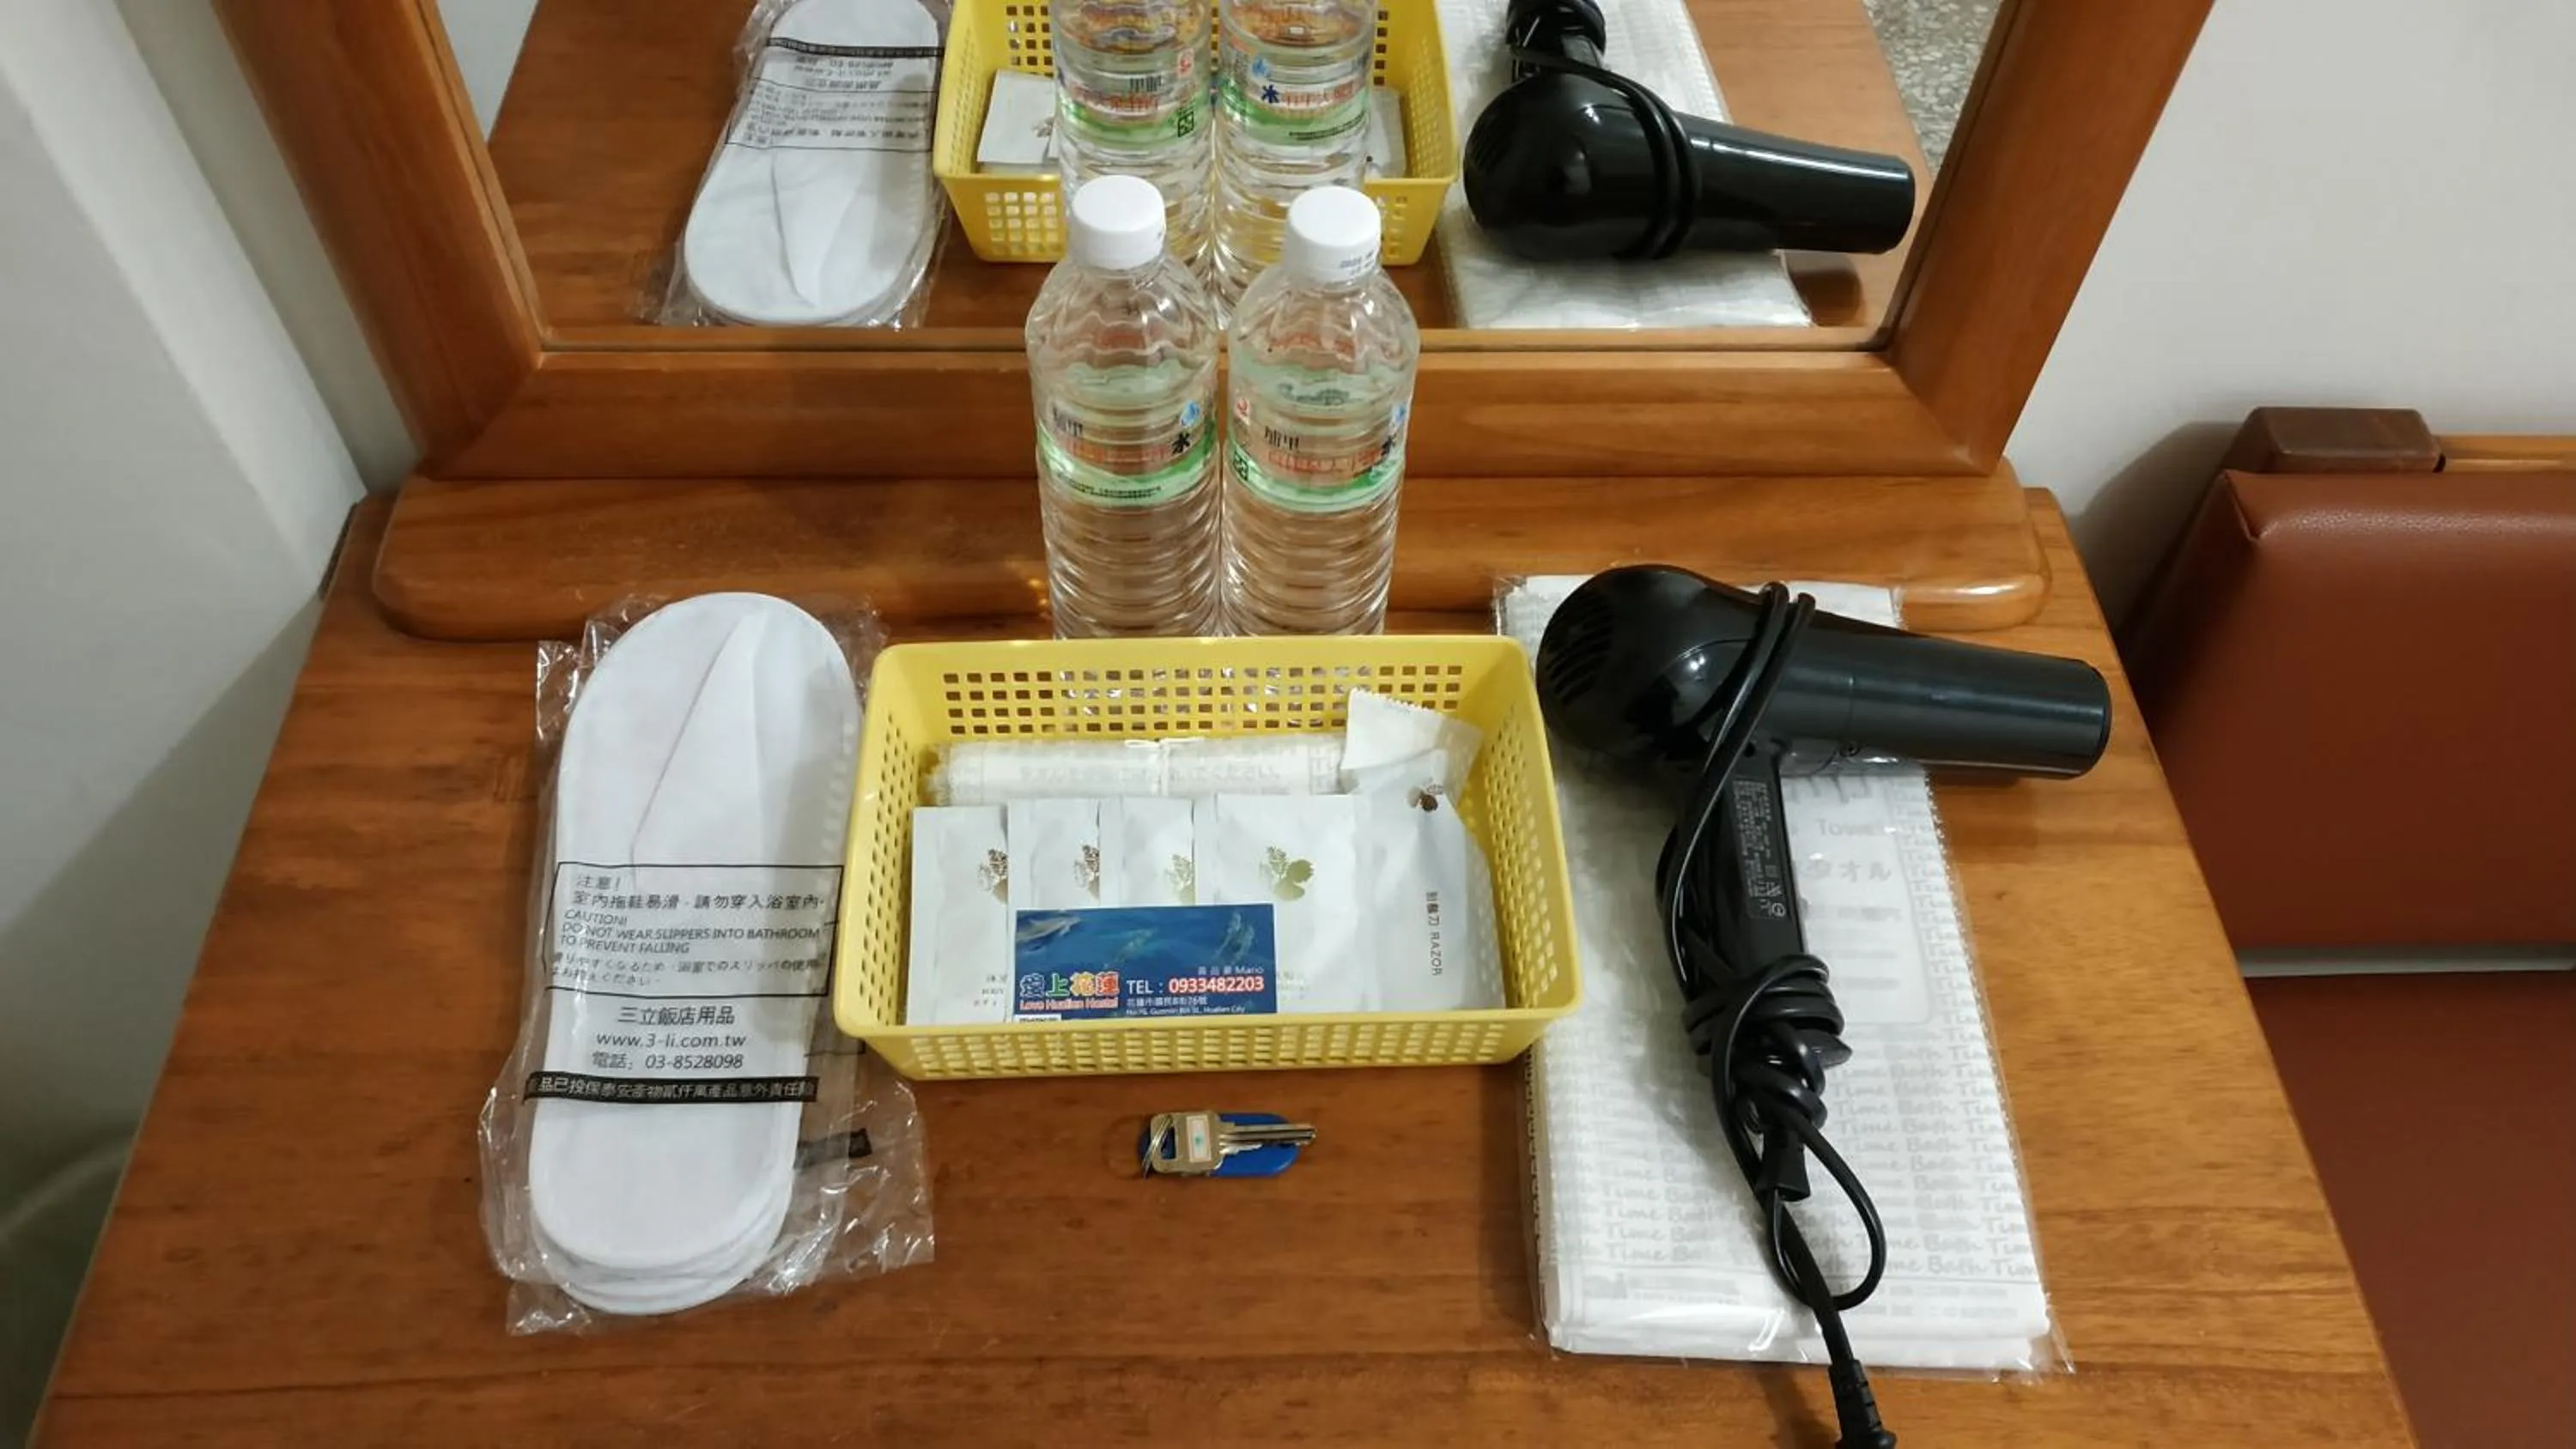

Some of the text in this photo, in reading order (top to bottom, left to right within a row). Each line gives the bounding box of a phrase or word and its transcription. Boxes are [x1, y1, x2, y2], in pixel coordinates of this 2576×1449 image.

[562, 922, 820, 941] DO NOT WEAR SLIPPERS INTO BATHROOM
[561, 934, 691, 955] TO PREVENT FALLING
[1430, 931, 1443, 977] RAZOR
[1168, 975, 1265, 995] 0933482203
[617, 1005, 736, 1027] 三立飯店用品
[596, 1033, 747, 1049] www.3-li.com.tw
[645, 1053, 744, 1070] 03-8528098
